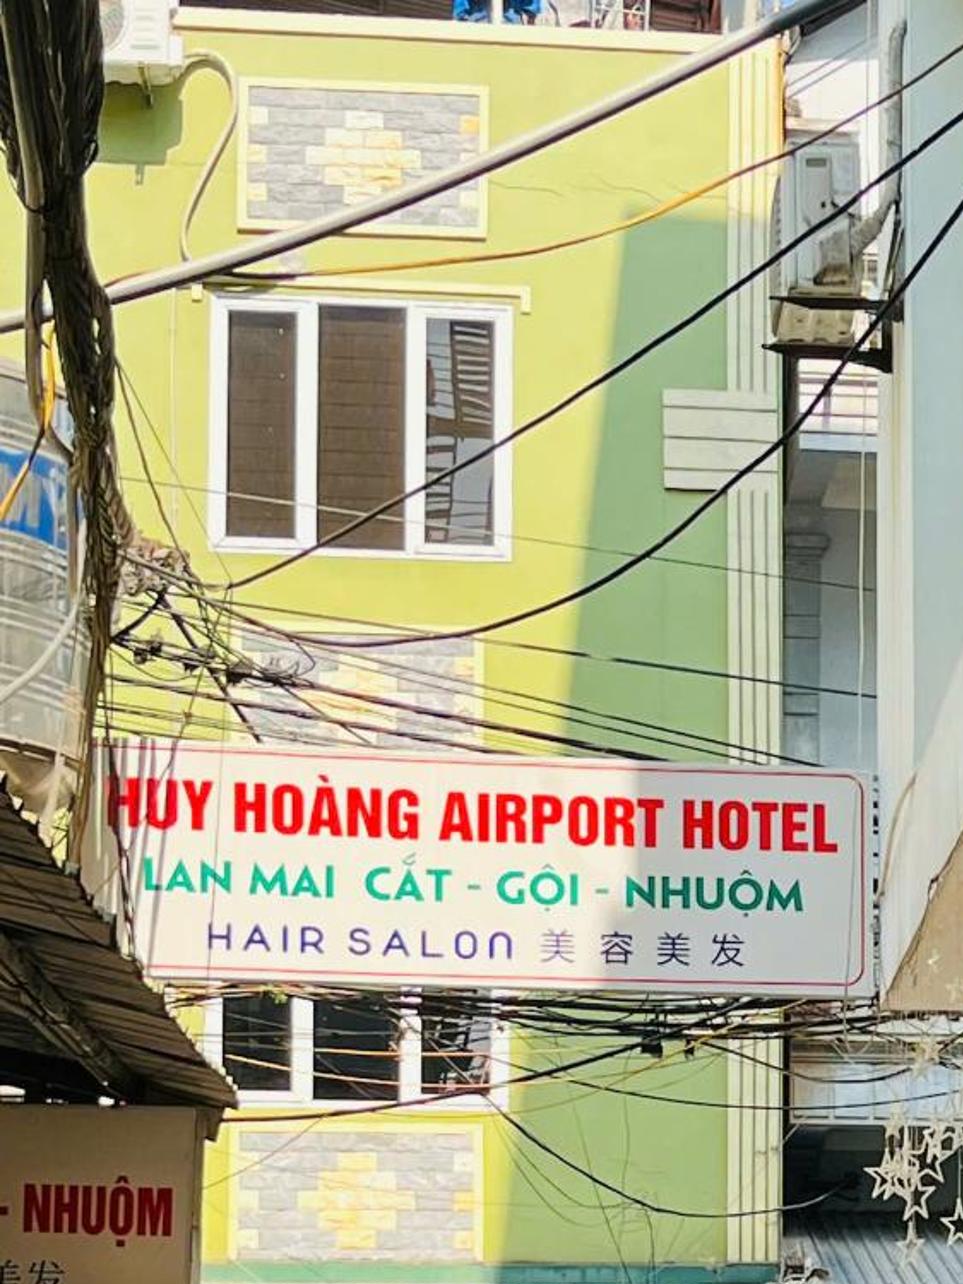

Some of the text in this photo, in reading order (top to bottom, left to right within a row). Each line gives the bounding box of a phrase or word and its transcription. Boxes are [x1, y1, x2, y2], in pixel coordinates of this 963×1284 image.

[106, 774, 838, 853] HUY HOÀNG AIRPORT HOTEL
[142, 857, 232, 894] LAN
[249, 863, 335, 899] MAI
[364, 852, 453, 903] CẮT
[496, 864, 579, 911] GỘI
[625, 869, 804, 917] NHUỘM
[207, 922, 325, 954] HAIR
[540, 929, 747, 968] 美容美发
[23, 1174, 173, 1248] NHUỘM
